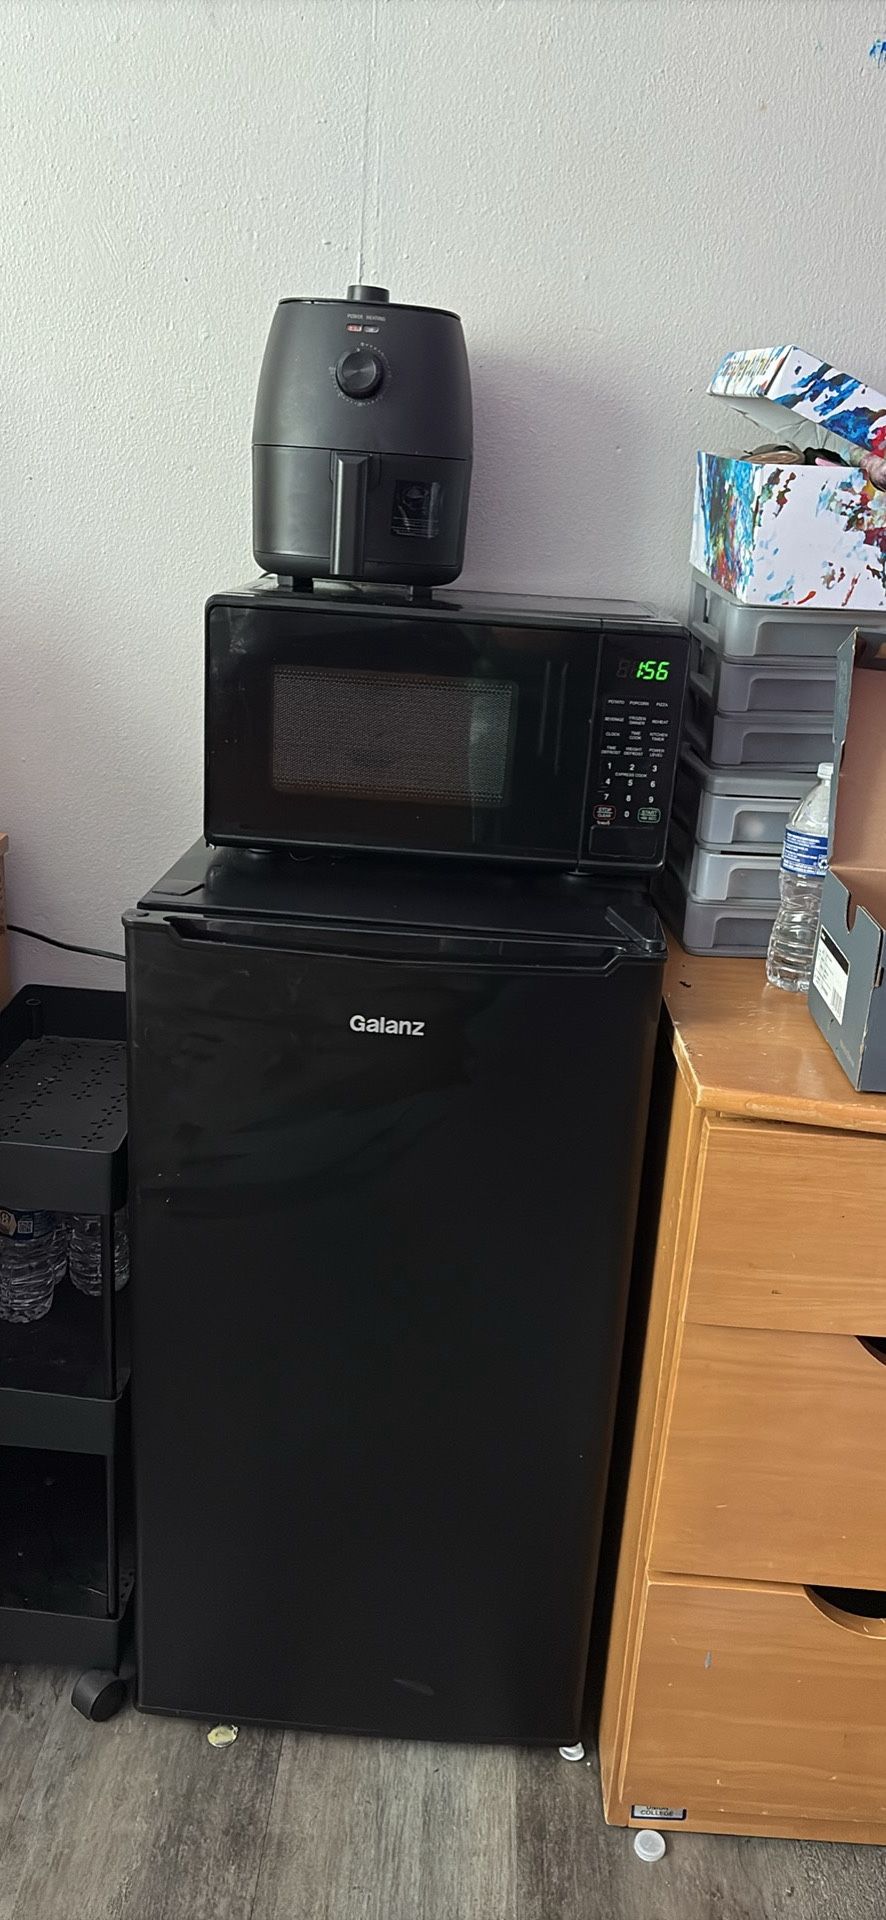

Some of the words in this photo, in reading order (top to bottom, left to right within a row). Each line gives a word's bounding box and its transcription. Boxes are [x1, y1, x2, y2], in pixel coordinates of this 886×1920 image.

[636, 661, 670, 680] 1:56
[650, 780, 656, 788] 6
[626, 794, 631, 802] 8
[349, 1014, 425, 1036] Galanz
